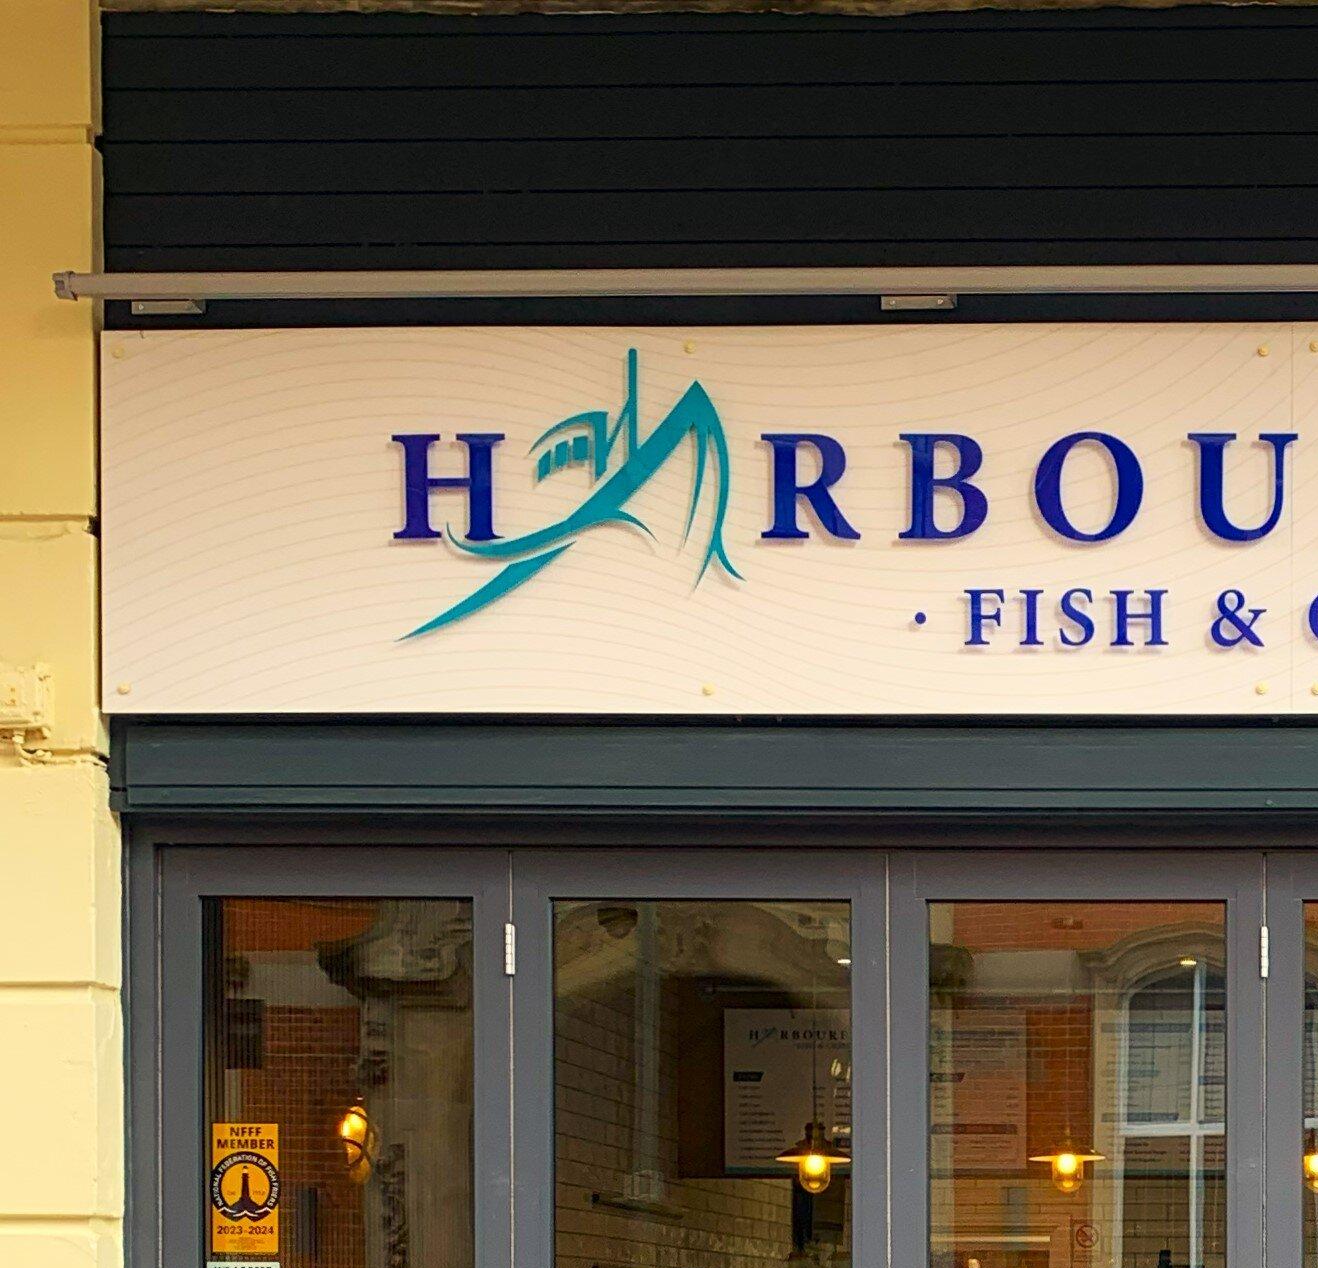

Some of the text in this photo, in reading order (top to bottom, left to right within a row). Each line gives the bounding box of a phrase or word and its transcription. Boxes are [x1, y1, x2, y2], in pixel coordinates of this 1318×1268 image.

[964, 589, 1169, 647] FISH
[1210, 590, 1264, 648] &
[229, 1126, 262, 1137] NFFF
[216, 1138, 275, 1150] MEMBER
